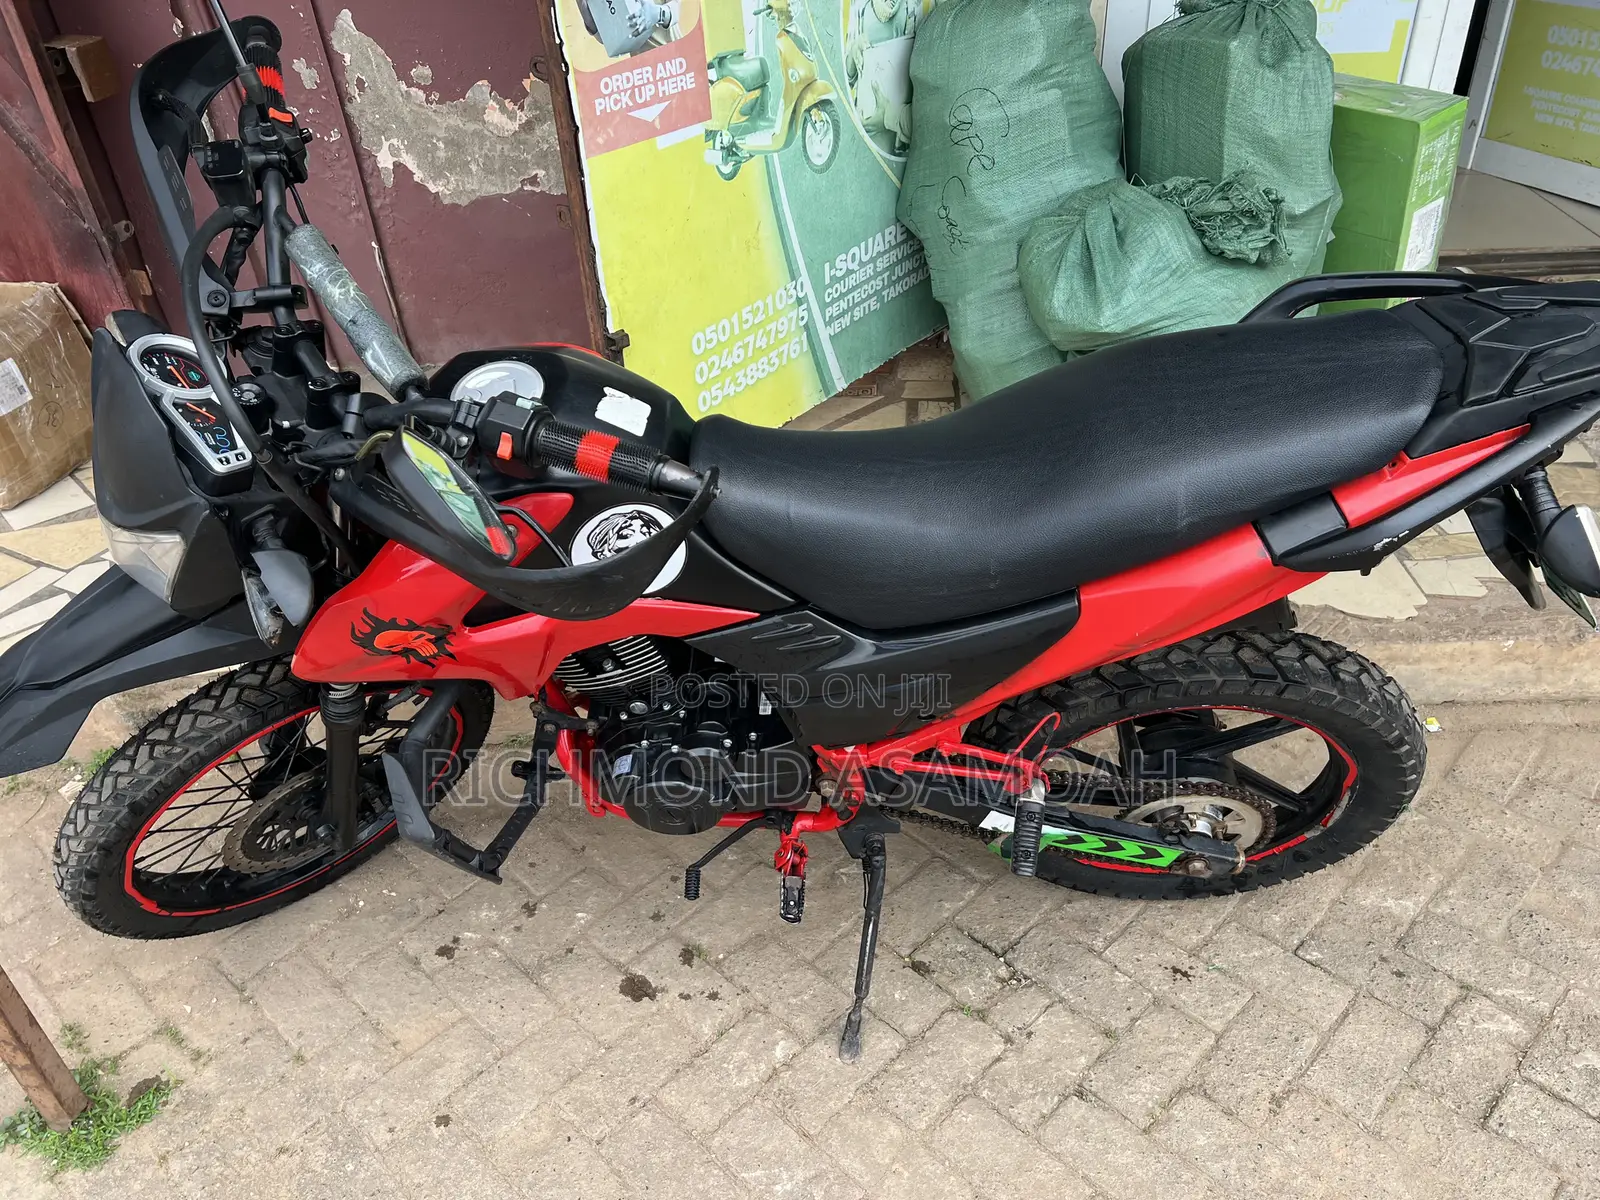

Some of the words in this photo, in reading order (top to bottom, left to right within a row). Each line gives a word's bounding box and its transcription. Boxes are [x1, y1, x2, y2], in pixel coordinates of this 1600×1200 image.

[594, 90, 633, 116] PICK
[634, 84, 656, 104] UP
[657, 72, 696, 98] HERE
[600, 66, 653, 95] ORDER
[655, 57, 687, 80] AND
[824, 222, 908, 286] I-SQUARE
[824, 263, 874, 303] COURIER
[825, 271, 890, 322] PENTECOST
[691, 276, 808, 356] 0501521030
[826, 312, 851, 337] NEW
[853, 296, 881, 321] SITE,
[695, 303, 809, 385] 0246747975
[697, 332, 808, 413] 0543883761
